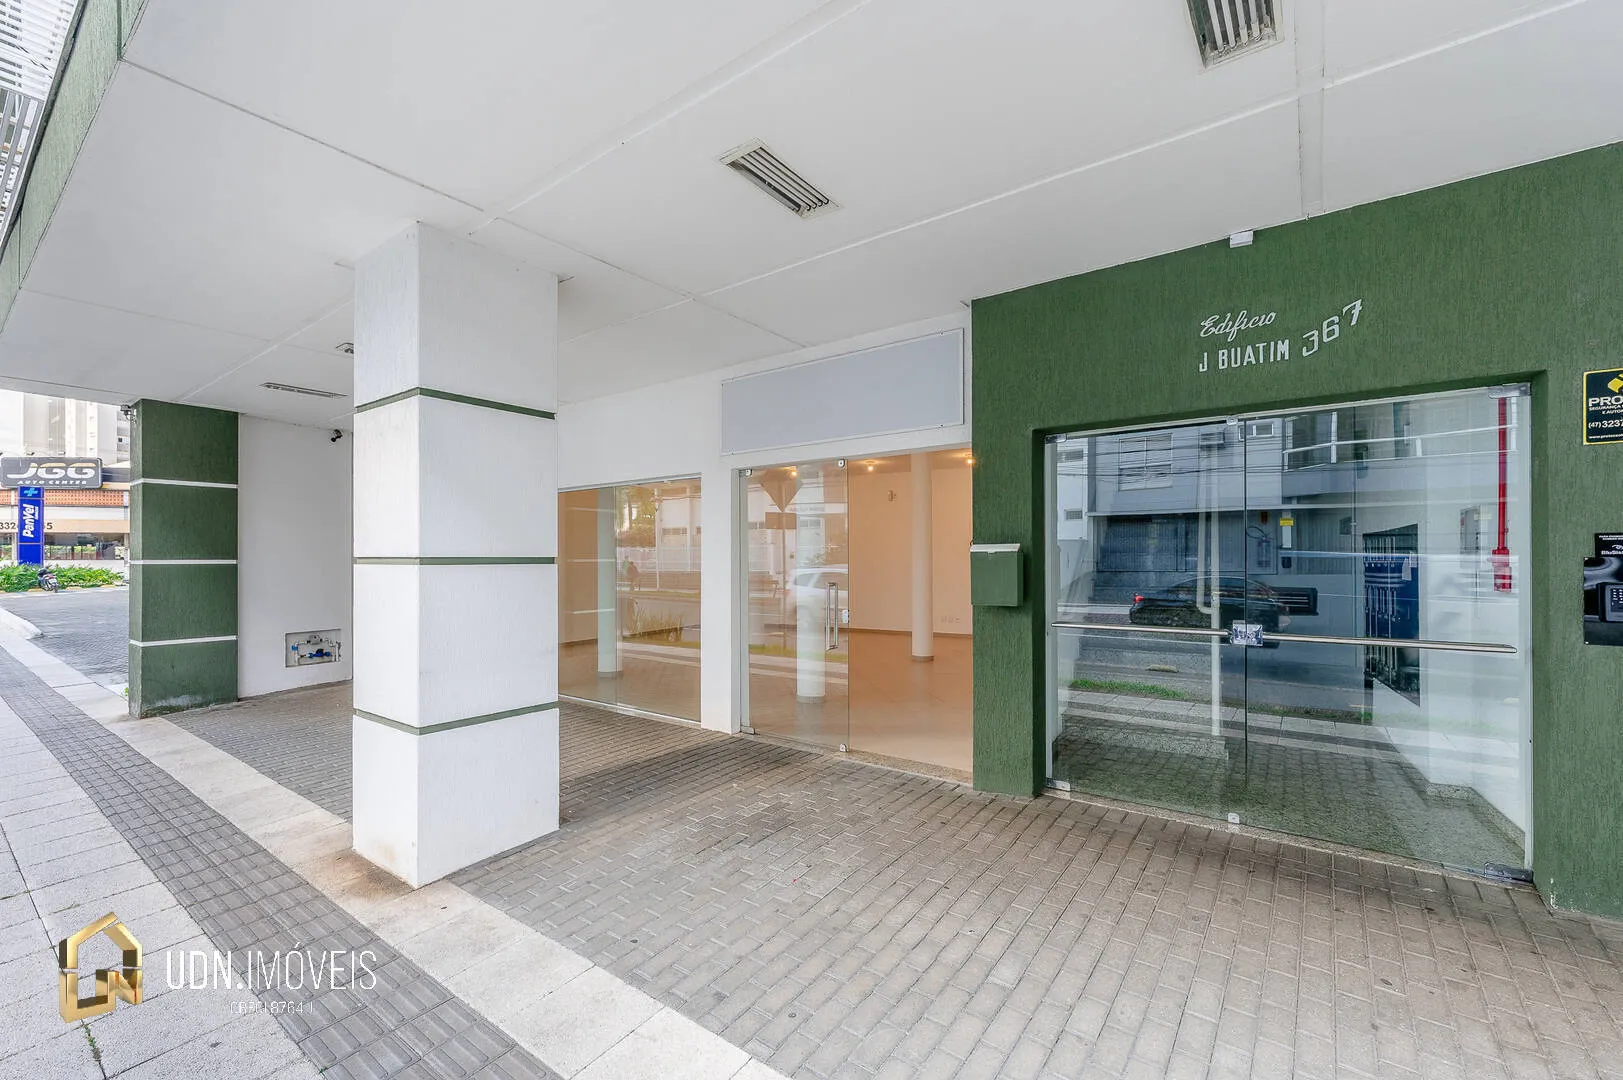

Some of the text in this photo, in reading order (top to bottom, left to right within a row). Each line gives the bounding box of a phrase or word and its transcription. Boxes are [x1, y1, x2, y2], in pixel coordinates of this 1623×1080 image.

[1199, 299, 1362, 372] J BUATIM 367
[1200, 310, 1276, 342] Edificio
[7, 462, 97, 479] JGG
